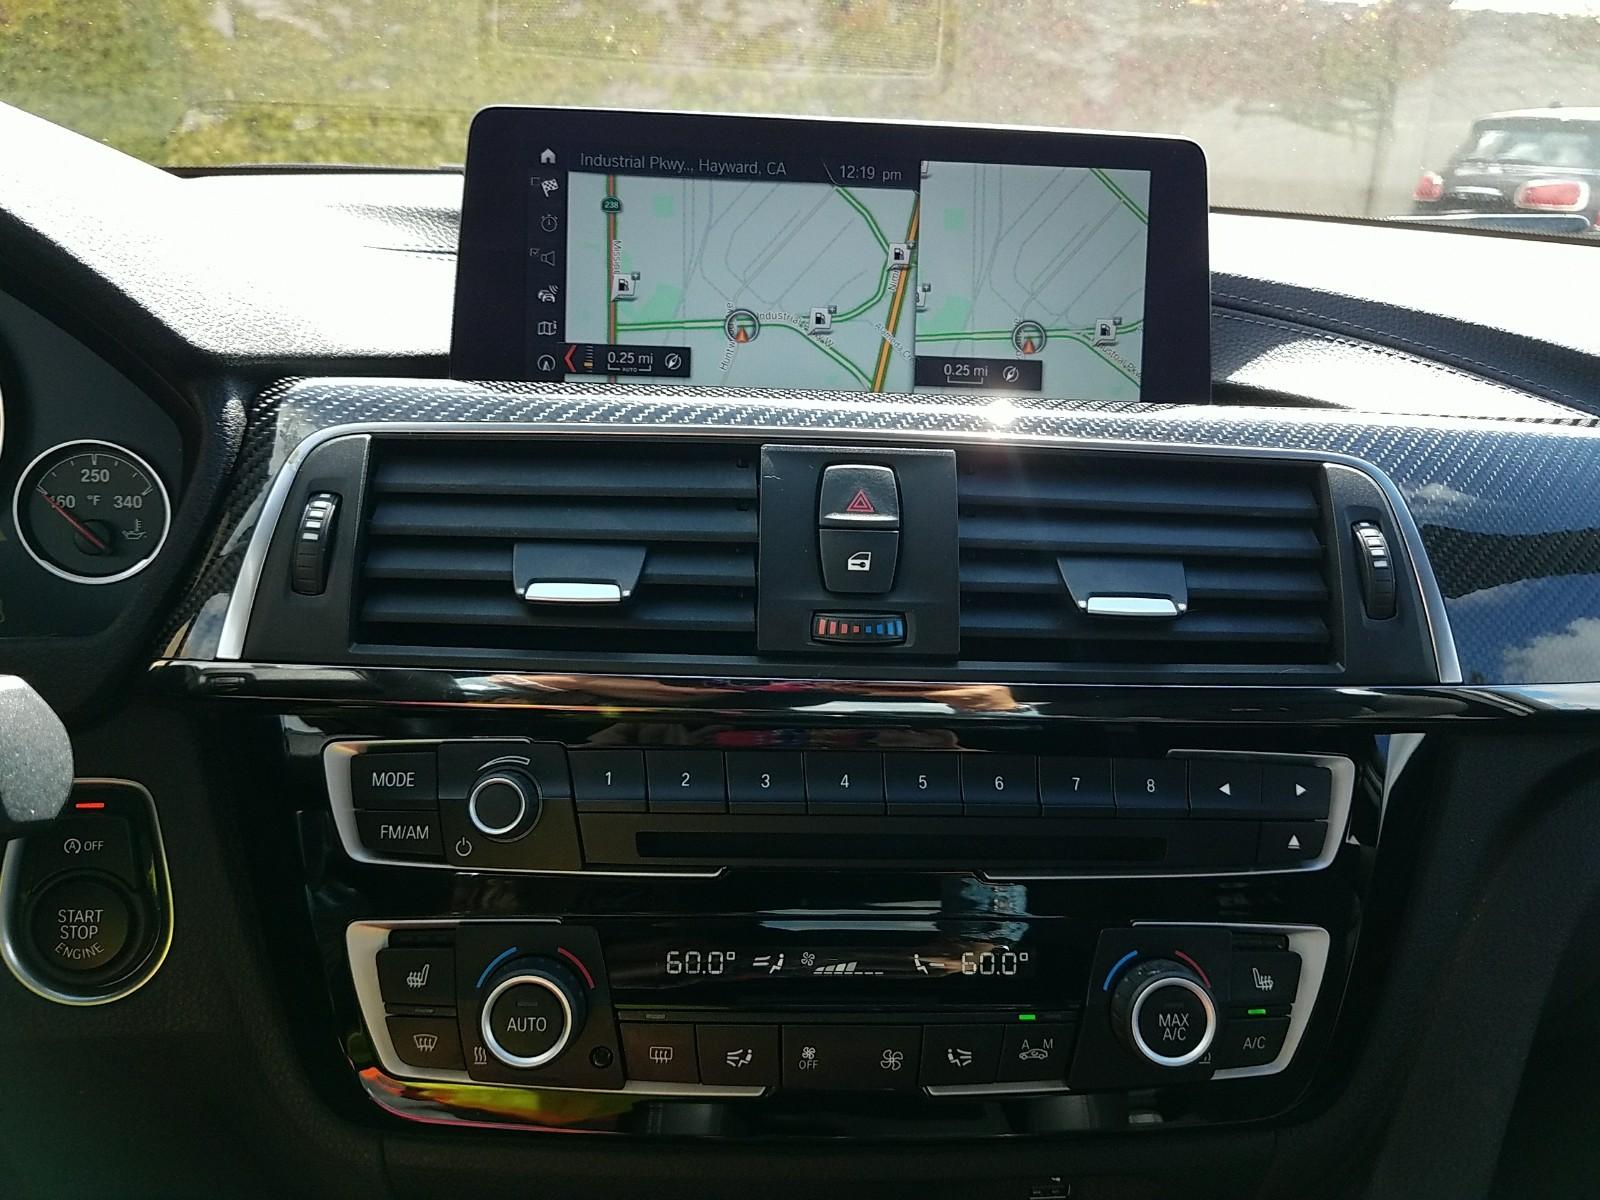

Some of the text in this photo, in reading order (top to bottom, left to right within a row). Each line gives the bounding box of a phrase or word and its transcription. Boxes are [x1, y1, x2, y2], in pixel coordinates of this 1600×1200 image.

[580, 152, 645, 169] Industrial
[766, 161, 787, 176] CA
[839, 164, 902, 183] 12:19 pm
[604, 200, 619, 209] 238
[607, 352, 653, 364] 0.25 mi
[943, 363, 988, 377] 0.25 mi
[80, 468, 110, 483] 250
[113, 495, 143, 509] 340
[372, 771, 415, 788] MODE
[604, 771, 612, 786] 1
[681, 772, 690, 788] 2
[761, 773, 770, 789] 3
[840, 774, 850, 789] 4
[918, 775, 928, 790] 5
[994, 775, 1004, 791] 6
[1071, 777, 1081, 791] 7
[1146, 778, 1156, 793] 8
[380, 824, 429, 841] FM/AM
[83, 840, 104, 851] OFF
[57, 909, 104, 923] START
[60, 925, 99, 940] STOP
[54, 942, 105, 959] ENGINE
[506, 1016, 547, 1032] AUTO
[1158, 1013, 1190, 1027] MAX
[1162, 1026, 1187, 1042] A/C
[1020, 1037, 1054, 1050] A M
[1242, 1036, 1267, 1050] A/C
[798, 1059, 819, 1070] OFF
